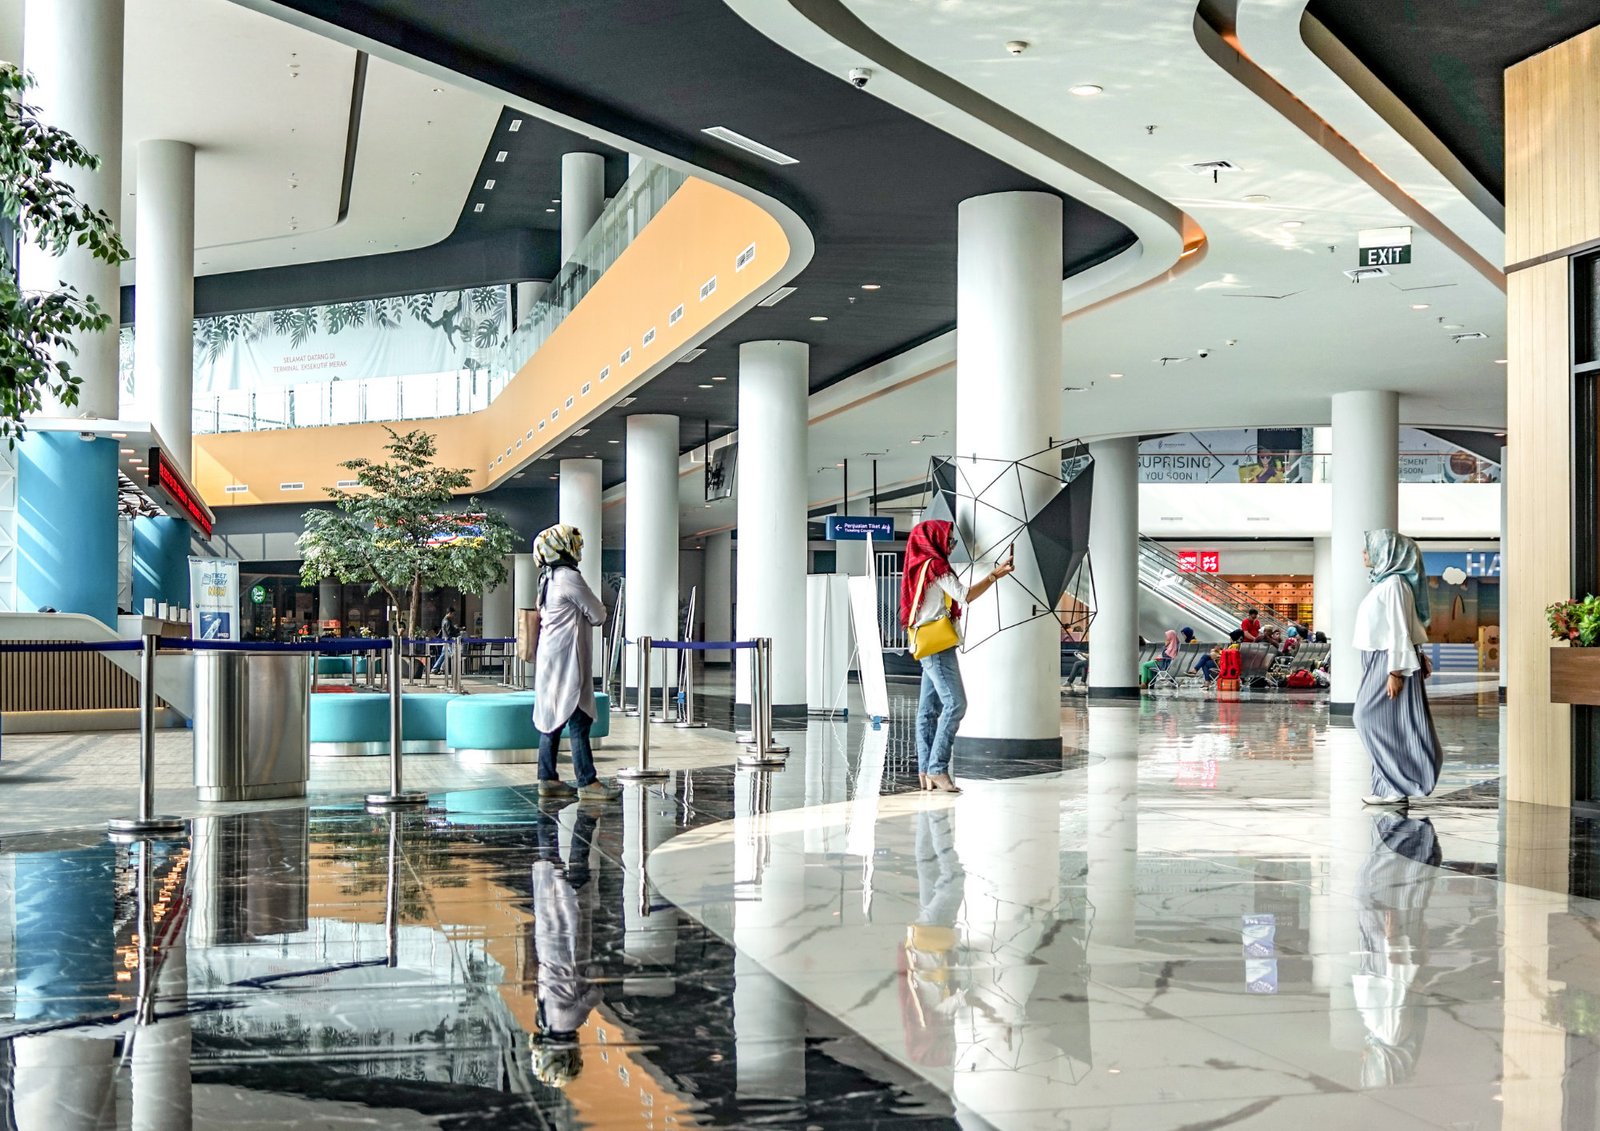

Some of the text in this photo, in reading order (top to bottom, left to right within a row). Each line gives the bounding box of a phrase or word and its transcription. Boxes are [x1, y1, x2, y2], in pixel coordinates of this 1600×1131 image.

[1368, 247, 1402, 265] EXIT
[283, 355, 306, 363] SELAMAT
[307, 353, 328, 361] DATANG
[273, 360, 347, 373] TERMINAL EKSEKUTIF MERAK
[1146, 472, 1163, 480] YOU
[1167, 472, 1193, 480] SOON
